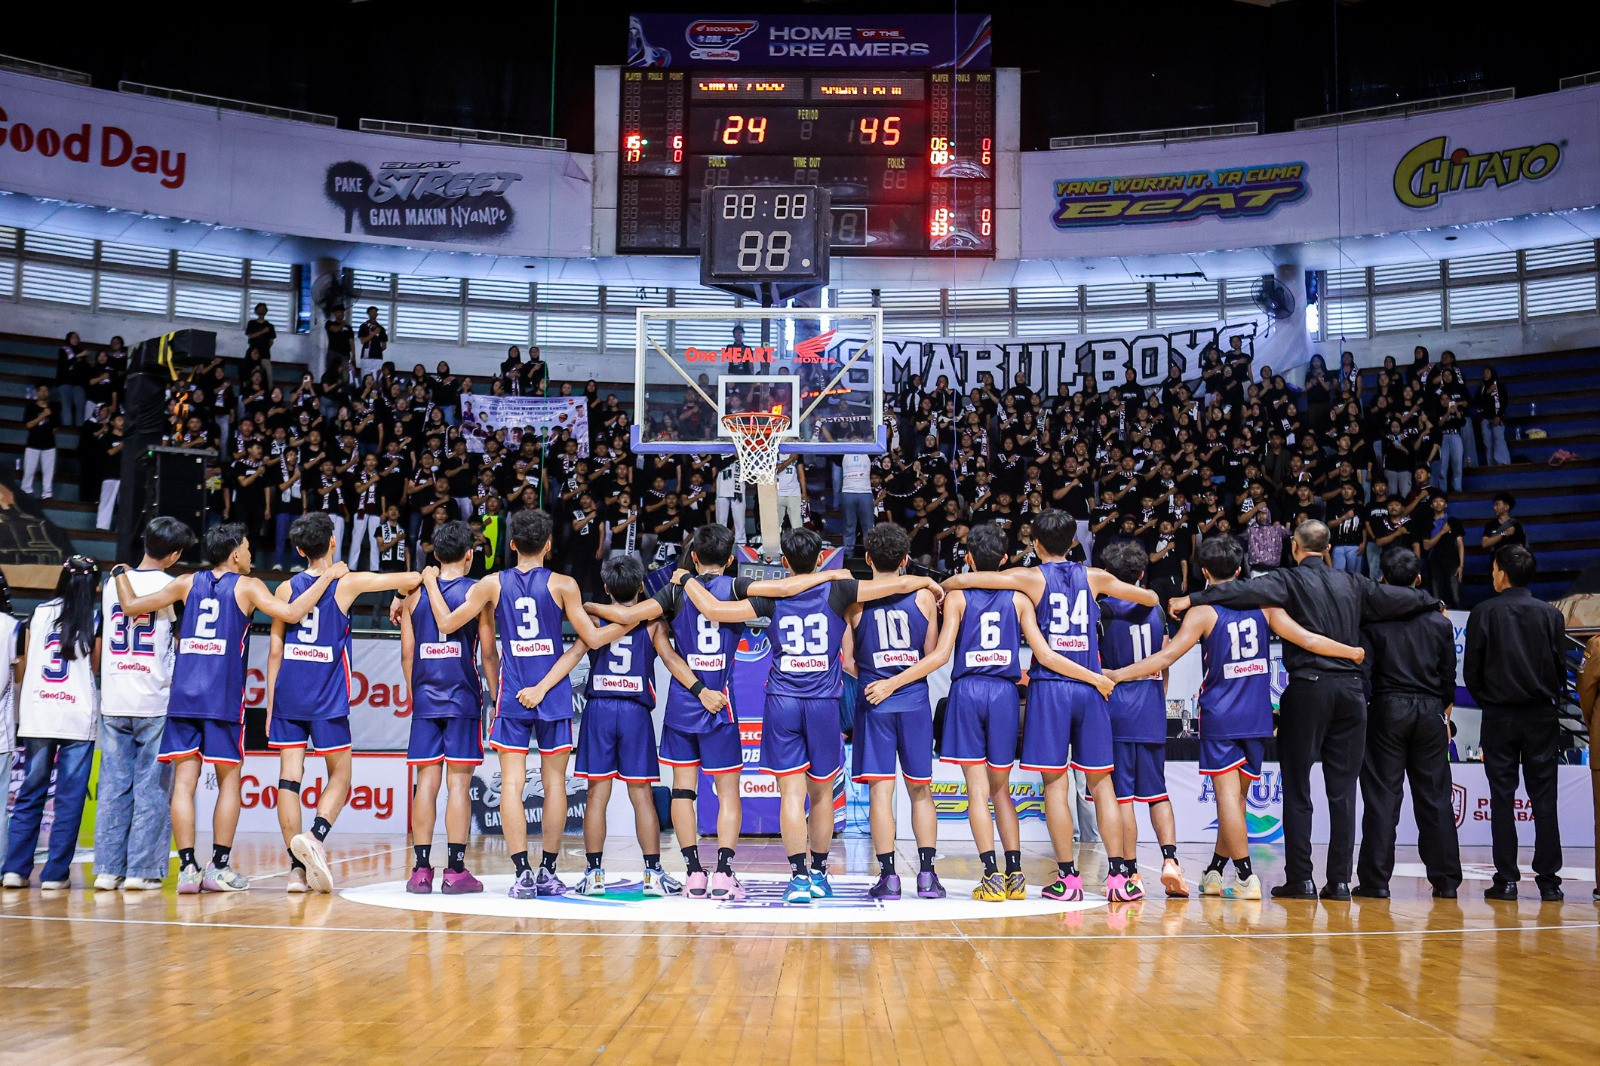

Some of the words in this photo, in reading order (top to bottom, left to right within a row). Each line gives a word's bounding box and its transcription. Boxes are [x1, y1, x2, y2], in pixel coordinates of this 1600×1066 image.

[769, 27, 852, 41] HOME
[769, 43, 930, 57] DREAMERS
[625, 73, 642, 81] PLAYER
[669, 73, 684, 81] POINT
[932, 74, 949, 82] PLAYER
[955, 74, 970, 82] FOULS
[977, 74, 991, 82] POINT
[798, 109, 819, 120] PERIOD
[722, 116, 768, 144] 24
[860, 116, 901, 146] 45
[673, 135, 683, 149] 6
[930, 137, 948, 151] 06
[982, 138, 991, 150] 0
[101, 126, 187, 189] Day
[673, 150, 682, 162] 0
[708, 157, 727, 168] FOULS
[793, 157, 807, 168] TIME
[809, 157, 821, 168] OUT
[930, 151, 948, 164] 08
[982, 152, 991, 164] 6
[887, 158, 906, 169] FOULS
[334, 177, 363, 193] PAKE
[367, 170, 523, 203] STREET
[1057, 180, 1110, 197] YANG
[1113, 175, 1185, 193] WORTH
[1217, 169, 1242, 186] YA
[1245, 164, 1304, 183] CUMA
[370, 208, 400, 226] GAYA
[405, 208, 447, 226] MAKIN
[933, 208, 947, 222] 13
[982, 208, 990, 222] 0
[930, 222, 947, 236] 33
[982, 222, 991, 236] 0
[685, 347, 718, 363] One
[195, 597, 220, 638] 2
[514, 597, 539, 639] 3
[1049, 590, 1089, 634] 34
[109, 603, 157, 657] 32
[297, 606, 320, 644] 9
[874, 608, 910, 650] 10
[980, 611, 1000, 650] 6
[697, 614, 721, 654] 8
[779, 612, 829, 654] 33
[1227, 617, 1258, 660] 13
[189, 641, 209, 651] Good
[209, 642, 222, 653] Day
[426, 645, 445, 655] Good
[515, 643, 534, 652] Good
[534, 642, 551, 654] Day
[1129, 623, 1152, 664] 11
[41, 631, 70, 683] 3
[292, 647, 313, 657] Good
[312, 648, 329, 660] Day
[608, 636, 633, 675] 5
[975, 653, 993, 663] Good
[993, 653, 1008, 664] Day
[117, 662, 135, 671] Good
[135, 663, 152, 674] Day
[694, 657, 715, 667] Good
[715, 659, 723, 667] Da
[790, 659, 810, 668] Good
[811, 659, 827, 670] Day
[602, 677, 623, 687] Good
[623, 679, 639, 691] Day
[39, 689, 59, 701] Good
[60, 691, 76, 704] Day
[742, 749, 760, 762] DB
[743, 781, 775, 794] Good
[240, 775, 322, 809] God
[343, 785, 394, 820] ay
